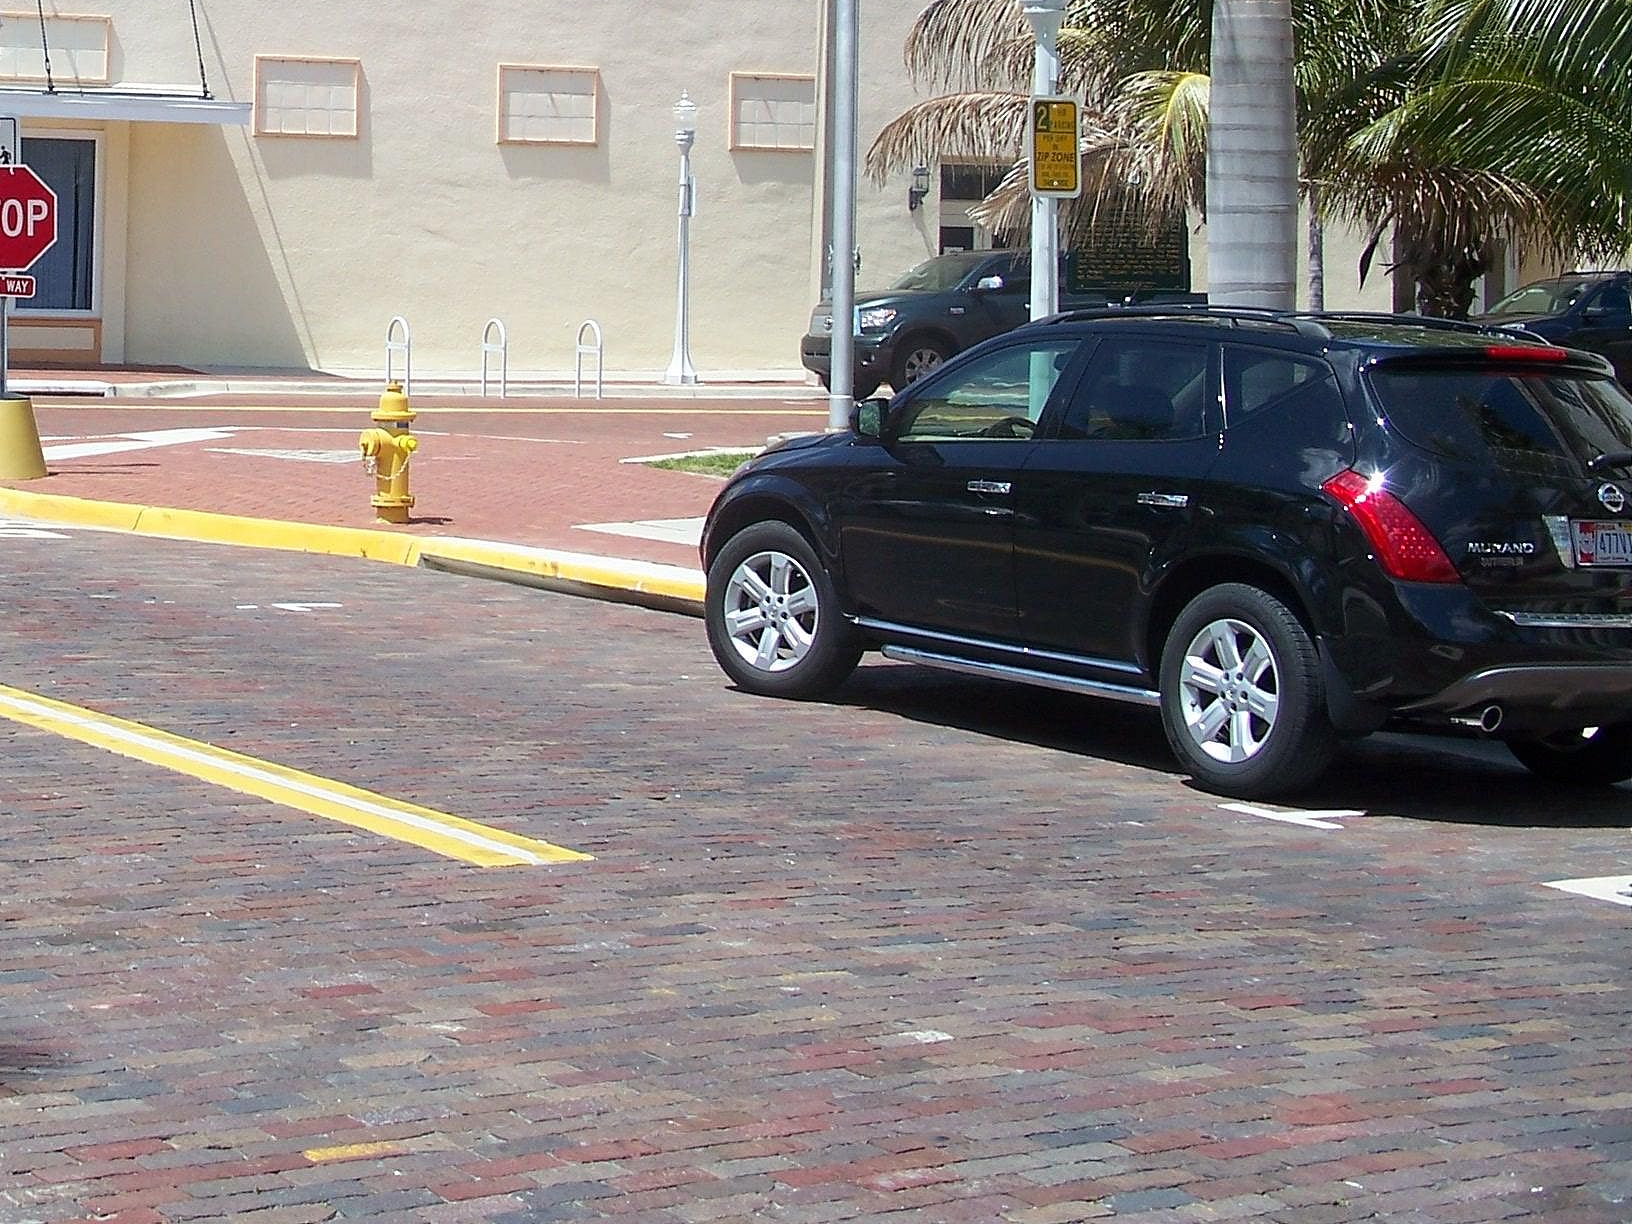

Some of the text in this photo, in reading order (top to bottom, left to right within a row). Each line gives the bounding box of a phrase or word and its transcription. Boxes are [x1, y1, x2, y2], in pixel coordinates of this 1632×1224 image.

[1037, 105, 1048, 129] 2
[1037, 152, 1074, 162] ZIP ZONE
[6, 279, 29, 293] WAY
[1468, 542, 1535, 554] MURANO
